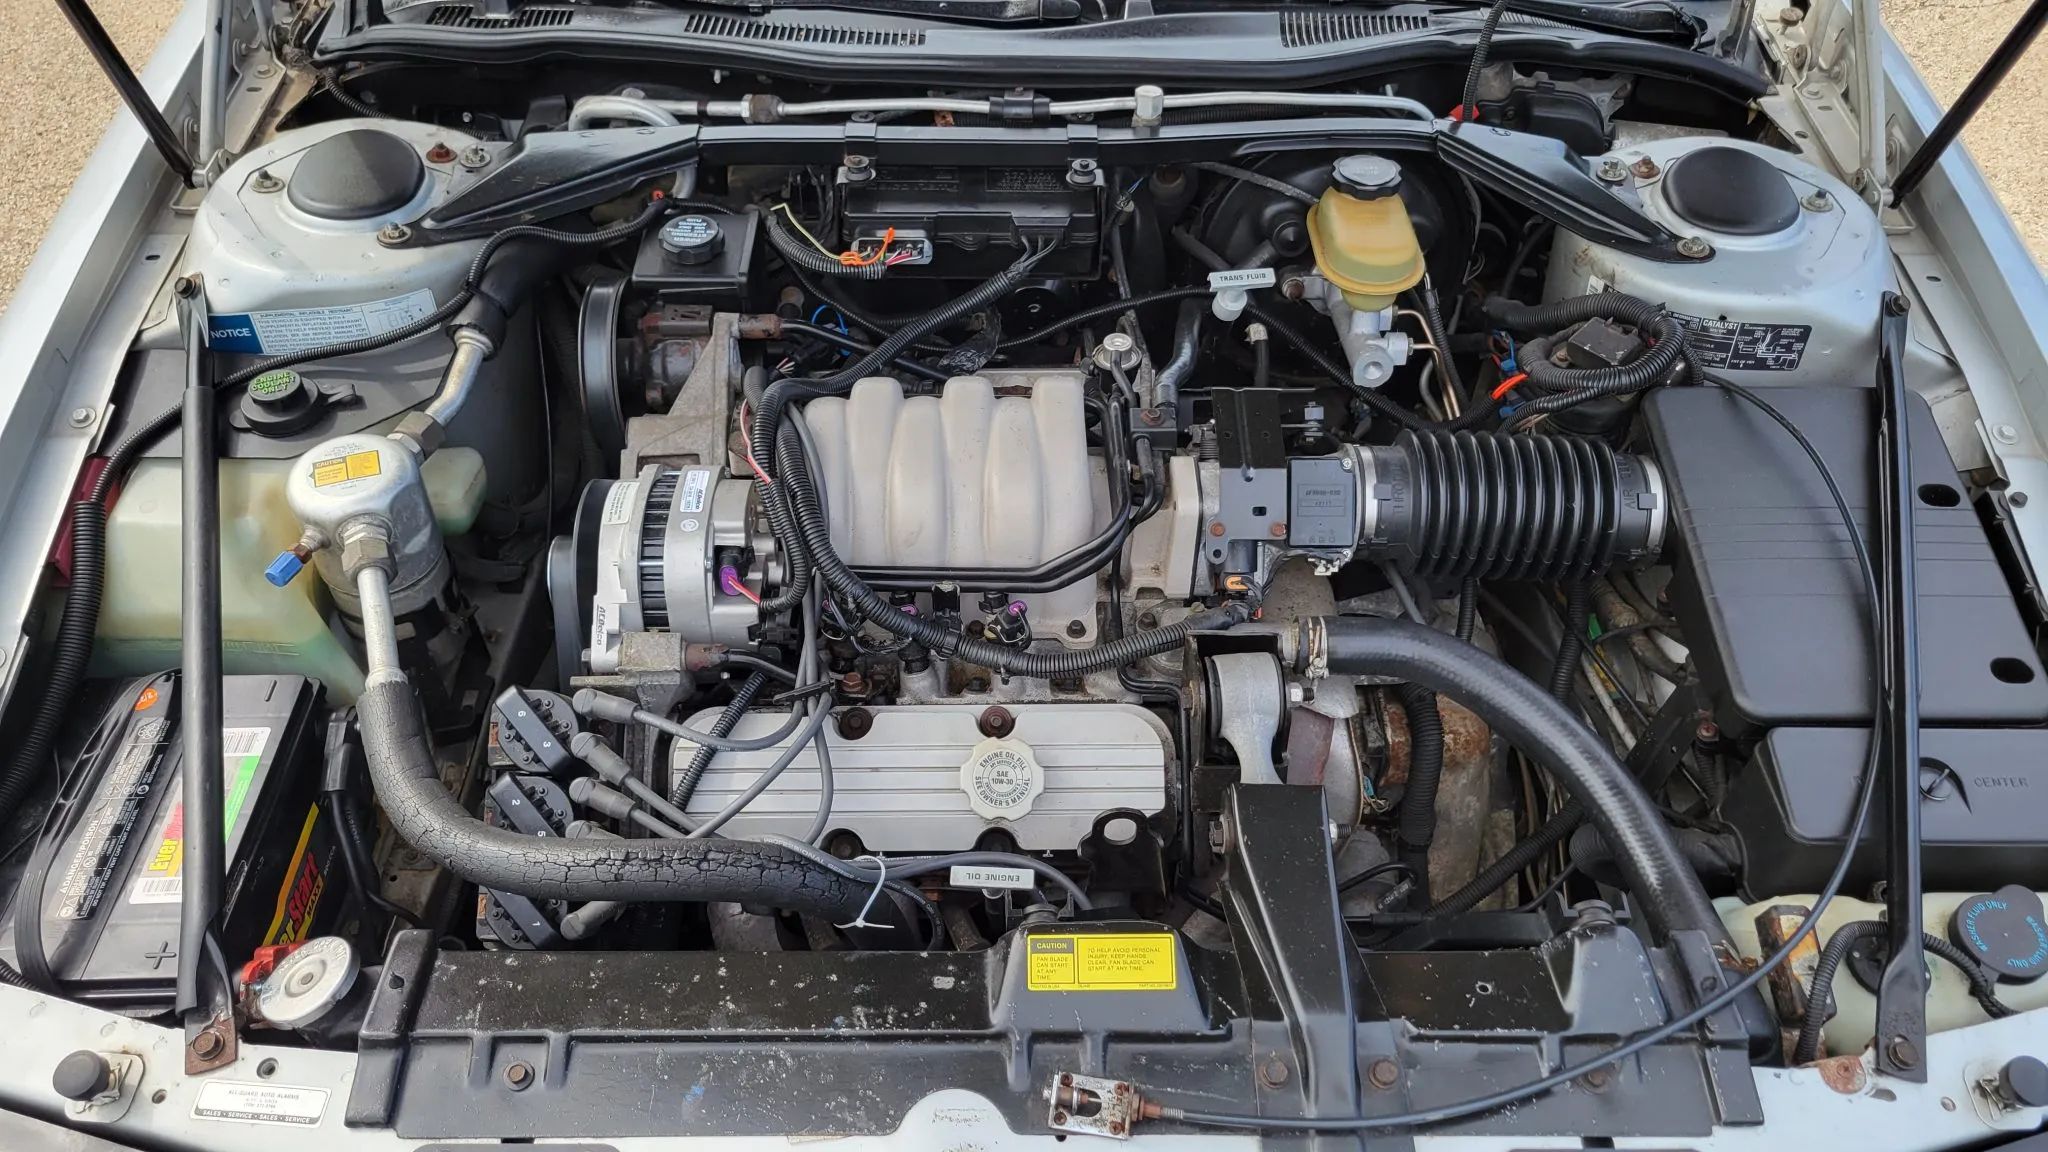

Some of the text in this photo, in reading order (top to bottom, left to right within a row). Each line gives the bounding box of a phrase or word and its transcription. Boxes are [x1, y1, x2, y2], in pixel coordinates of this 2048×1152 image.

[1702, 319, 1738, 330] CATALYST
[210, 328, 252, 339] NOTICE
[252, 376, 296, 392] COOLANT
[254, 372, 290, 385] ENGINE
[262, 384, 288, 394] ONLY
[316, 458, 344, 468] CAUTION
[980, 751, 1028, 770] ENGINE OIL FILL
[1974, 776, 2030, 788] CENTER
[976, 776, 1030, 806] SEE OWNER'S MANUAL
[966, 872, 1020, 882] ENGINE OIL
[306, 878, 322, 918] MAXX
[1966, 900, 2008, 952] WASHER FLUID ONLY
[2007, 958, 2029, 968] ONLY
[228, 1110, 252, 1120] SERVICE
[284, 1115, 311, 1124] SERVICE
